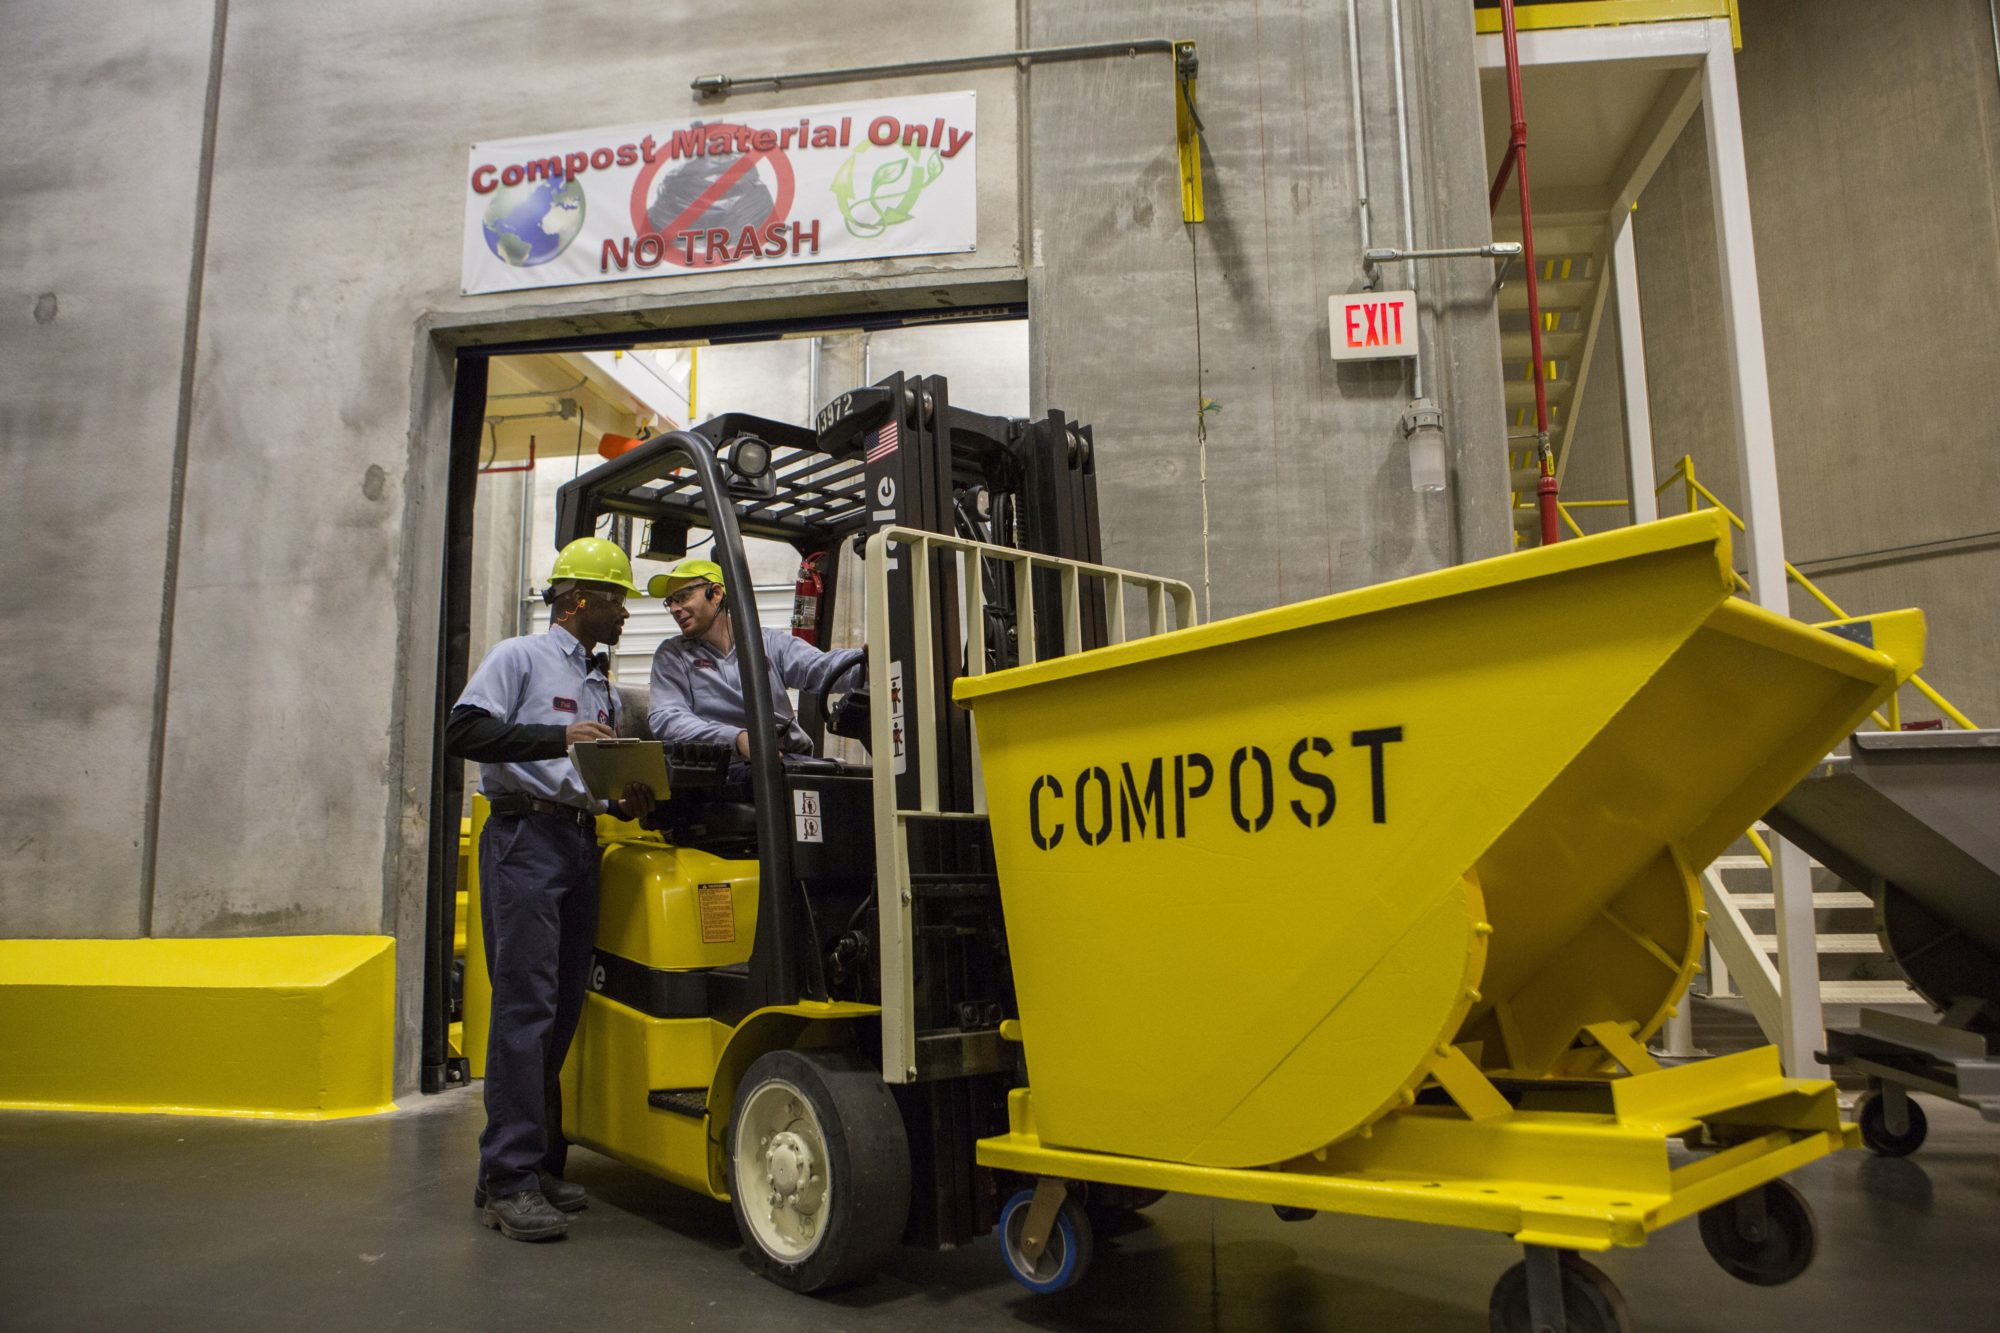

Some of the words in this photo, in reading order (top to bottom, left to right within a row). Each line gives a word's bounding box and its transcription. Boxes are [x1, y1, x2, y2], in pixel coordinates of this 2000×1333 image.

[471, 133, 656, 195] Compost
[671, 116, 852, 159] Material
[867, 115, 973, 159] Only
[600, 232, 665, 273] NO
[677, 218, 820, 265] TRASH
[1345, 301, 1404, 348] EXIT
[816, 393, 854, 437] 13972
[1029, 724, 1405, 852] COMPOST
